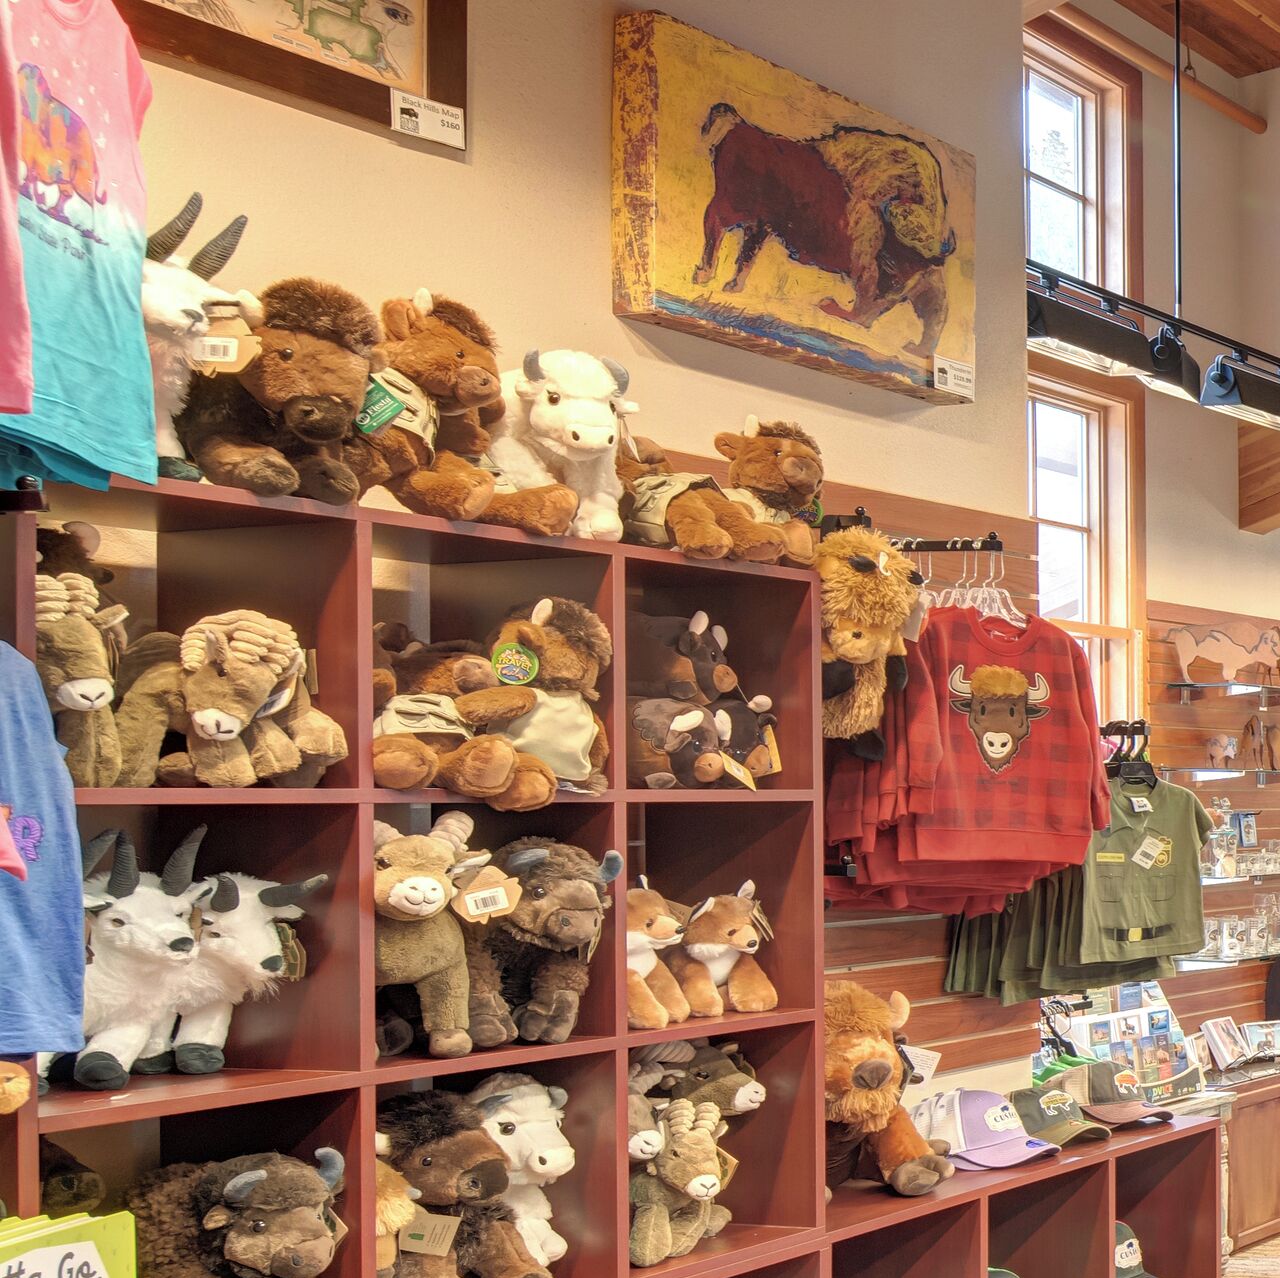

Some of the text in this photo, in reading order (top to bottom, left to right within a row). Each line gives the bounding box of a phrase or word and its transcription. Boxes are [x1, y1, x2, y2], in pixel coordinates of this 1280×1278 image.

[401, 96, 460, 120] Black Hills Map
[440, 119, 460, 131] $160
[366, 395, 391, 415] Fiesta
[498, 657, 530, 672] TRAVEL
